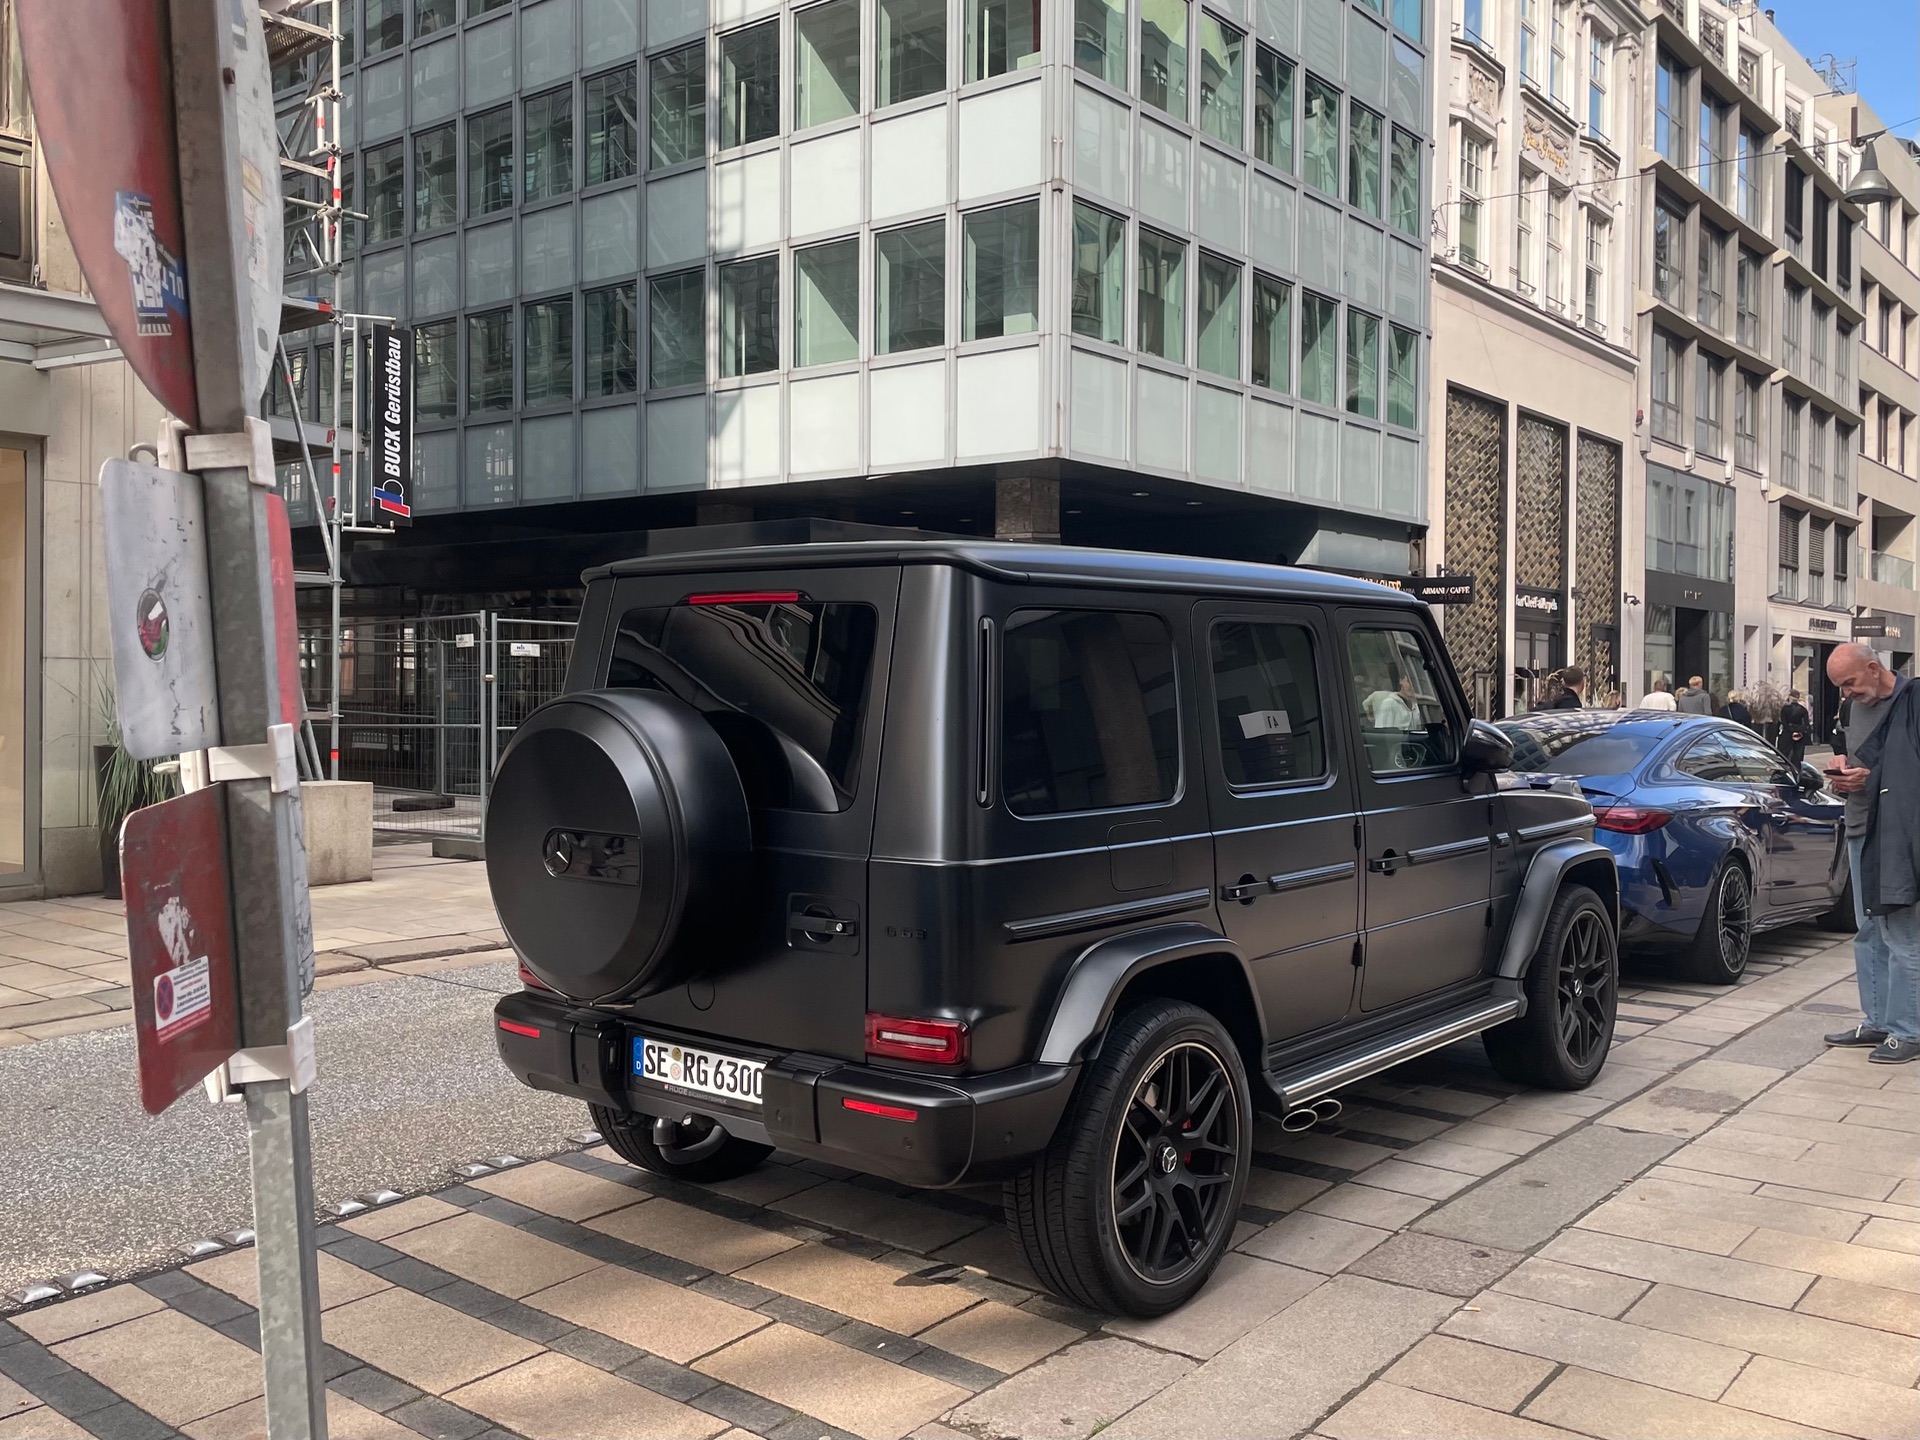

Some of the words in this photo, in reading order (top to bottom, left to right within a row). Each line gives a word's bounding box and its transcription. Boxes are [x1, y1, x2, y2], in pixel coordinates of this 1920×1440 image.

[384, 336, 402, 425] Gerüstbau
[384, 425, 401, 478] BUCK
[1422, 586, 1446, 595] ARMANI
[645, 1045, 668, 1078] SE
[683, 1052, 709, 1087] RG
[714, 1059, 763, 1099] 6300
